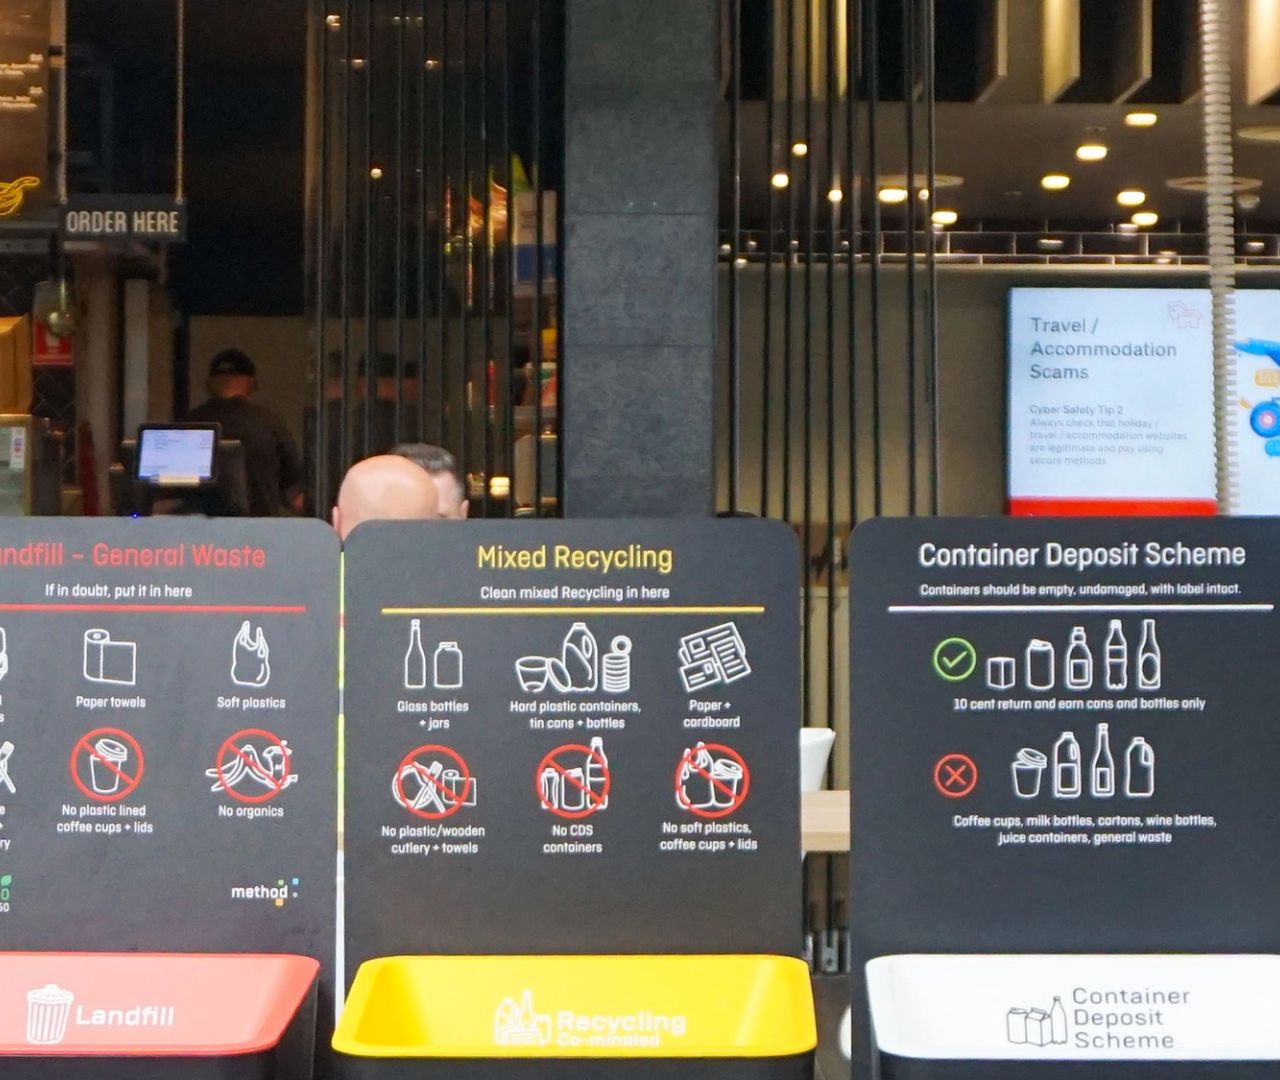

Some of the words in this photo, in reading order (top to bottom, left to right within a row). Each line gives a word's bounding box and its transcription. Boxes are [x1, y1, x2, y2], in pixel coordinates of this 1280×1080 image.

[67, 211, 126, 232] ORDER
[134, 211, 178, 232] HERE
[1030, 317, 1085, 332] Travel
[1030, 341, 1177, 357] Accommodation
[1030, 363, 1089, 379] Scams
[92, 543, 184, 567] General
[192, 544, 265, 568] Waste
[478, 545, 545, 568] Mixed
[555, 545, 672, 573] Recycling
[919, 543, 1039, 566] Container
[1046, 542, 1139, 571] Deposit
[1146, 542, 1245, 565] Scheme
[46, 584, 55, 596] If
[58, 584, 68, 596] in
[72, 584, 110, 597] doubt,
[115, 585, 135, 599] put
[139, 584, 147, 596] it
[150, 585, 161, 597] in
[165, 584, 192, 597] here
[481, 586, 516, 599] Clean
[520, 586, 558, 599] mixed
[562, 586, 623, 601] Recycling
[627, 586, 638, 598] in
[642, 586, 669, 598] here
[920, 584, 980, 595] Containers
[983, 584, 1020, 595] should
[1022, 584, 1036, 595] be
[1038, 585, 1076, 597] empty,
[1079, 584, 1148, 597] undamaged,
[1151, 583, 1174, 594] with
[1177, 583, 1204, 594] label
[1207, 584, 1241, 594] intact.
[76, 696, 108, 709] Paper
[111, 696, 146, 707] towels
[217, 697, 240, 708] Soft
[243, 697, 285, 710] plastics
[398, 701, 427, 712] Glass
[430, 700, 469, 711] bottles
[510, 701, 536, 712] Hard
[539, 701, 576, 714] plastic
[579, 700, 641, 712] containers,
[690, 700, 722, 713] Paper
[954, 698, 967, 710] 10
[970, 699, 995, 709] cent
[998, 699, 1032, 709] return
[1034, 698, 1056, 709] and
[1058, 700, 1084, 709] earn
[1086, 700, 1114, 709] cans
[1116, 698, 1137, 709] and
[1140, 697, 1179, 709] bottles
[1181, 698, 1205, 710] only
[428, 717, 449, 731] jars
[530, 717, 544, 728] tin
[547, 720, 574, 728] cans
[587, 717, 625, 728] bottles
[683, 716, 740, 727] cardboard
[954, 815, 991, 827] Coffee
[993, 817, 1023, 828] cups,
[1026, 815, 1050, 826] milk
[1052, 815, 1095, 827] bottles,
[1098, 816, 1143, 826] cartons,
[1146, 815, 1172, 825] wine
[1174, 815, 1216, 826] bottles,
[553, 825, 567, 836] No
[570, 825, 593, 836] CDS
[543, 842, 602, 853] containers
[232, 882, 287, 900] method
[1073, 988, 1189, 1004] Container
[76, 1005, 174, 1025] Landfill
[1074, 1009, 1162, 1028] Deposit
[557, 1010, 687, 1036] Recycling
[1075, 1032, 1173, 1048] Scheme
